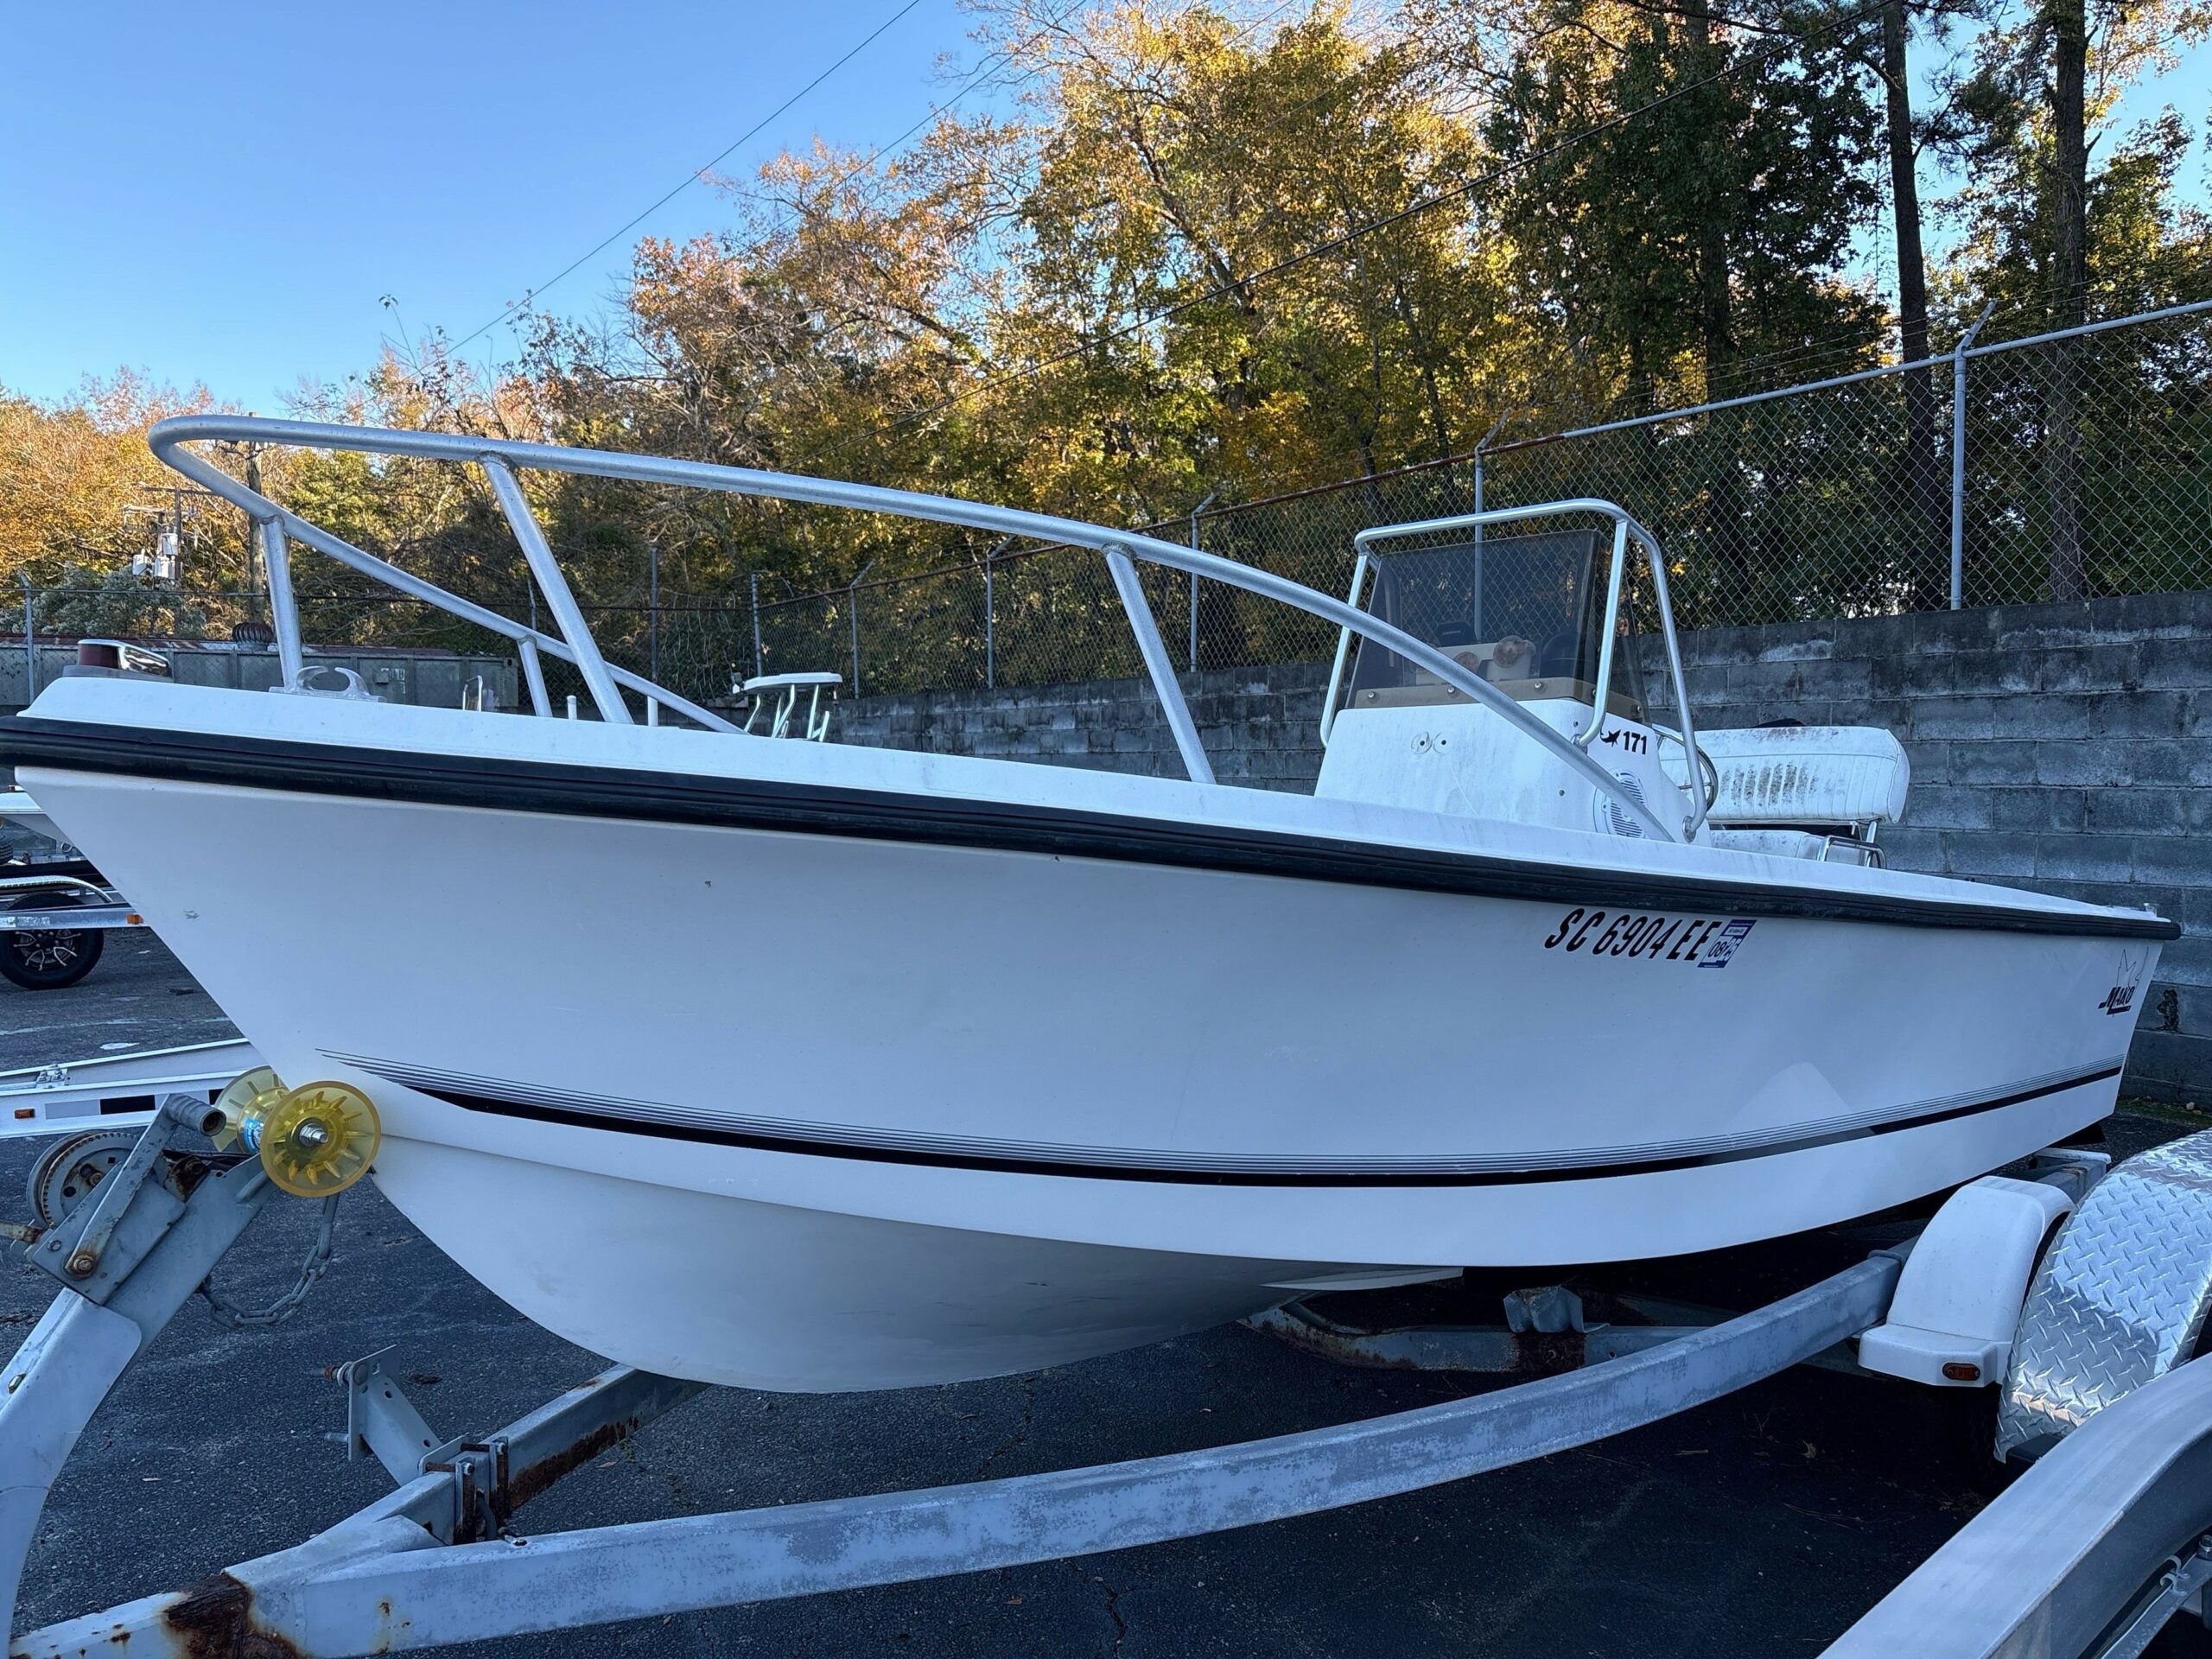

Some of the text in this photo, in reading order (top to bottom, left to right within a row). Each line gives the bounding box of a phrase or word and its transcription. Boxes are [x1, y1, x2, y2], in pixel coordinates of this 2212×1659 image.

[1623, 730, 1648, 756] 171
[1544, 907, 1606, 953] SC
[2098, 986, 2136, 1015] MAKO
